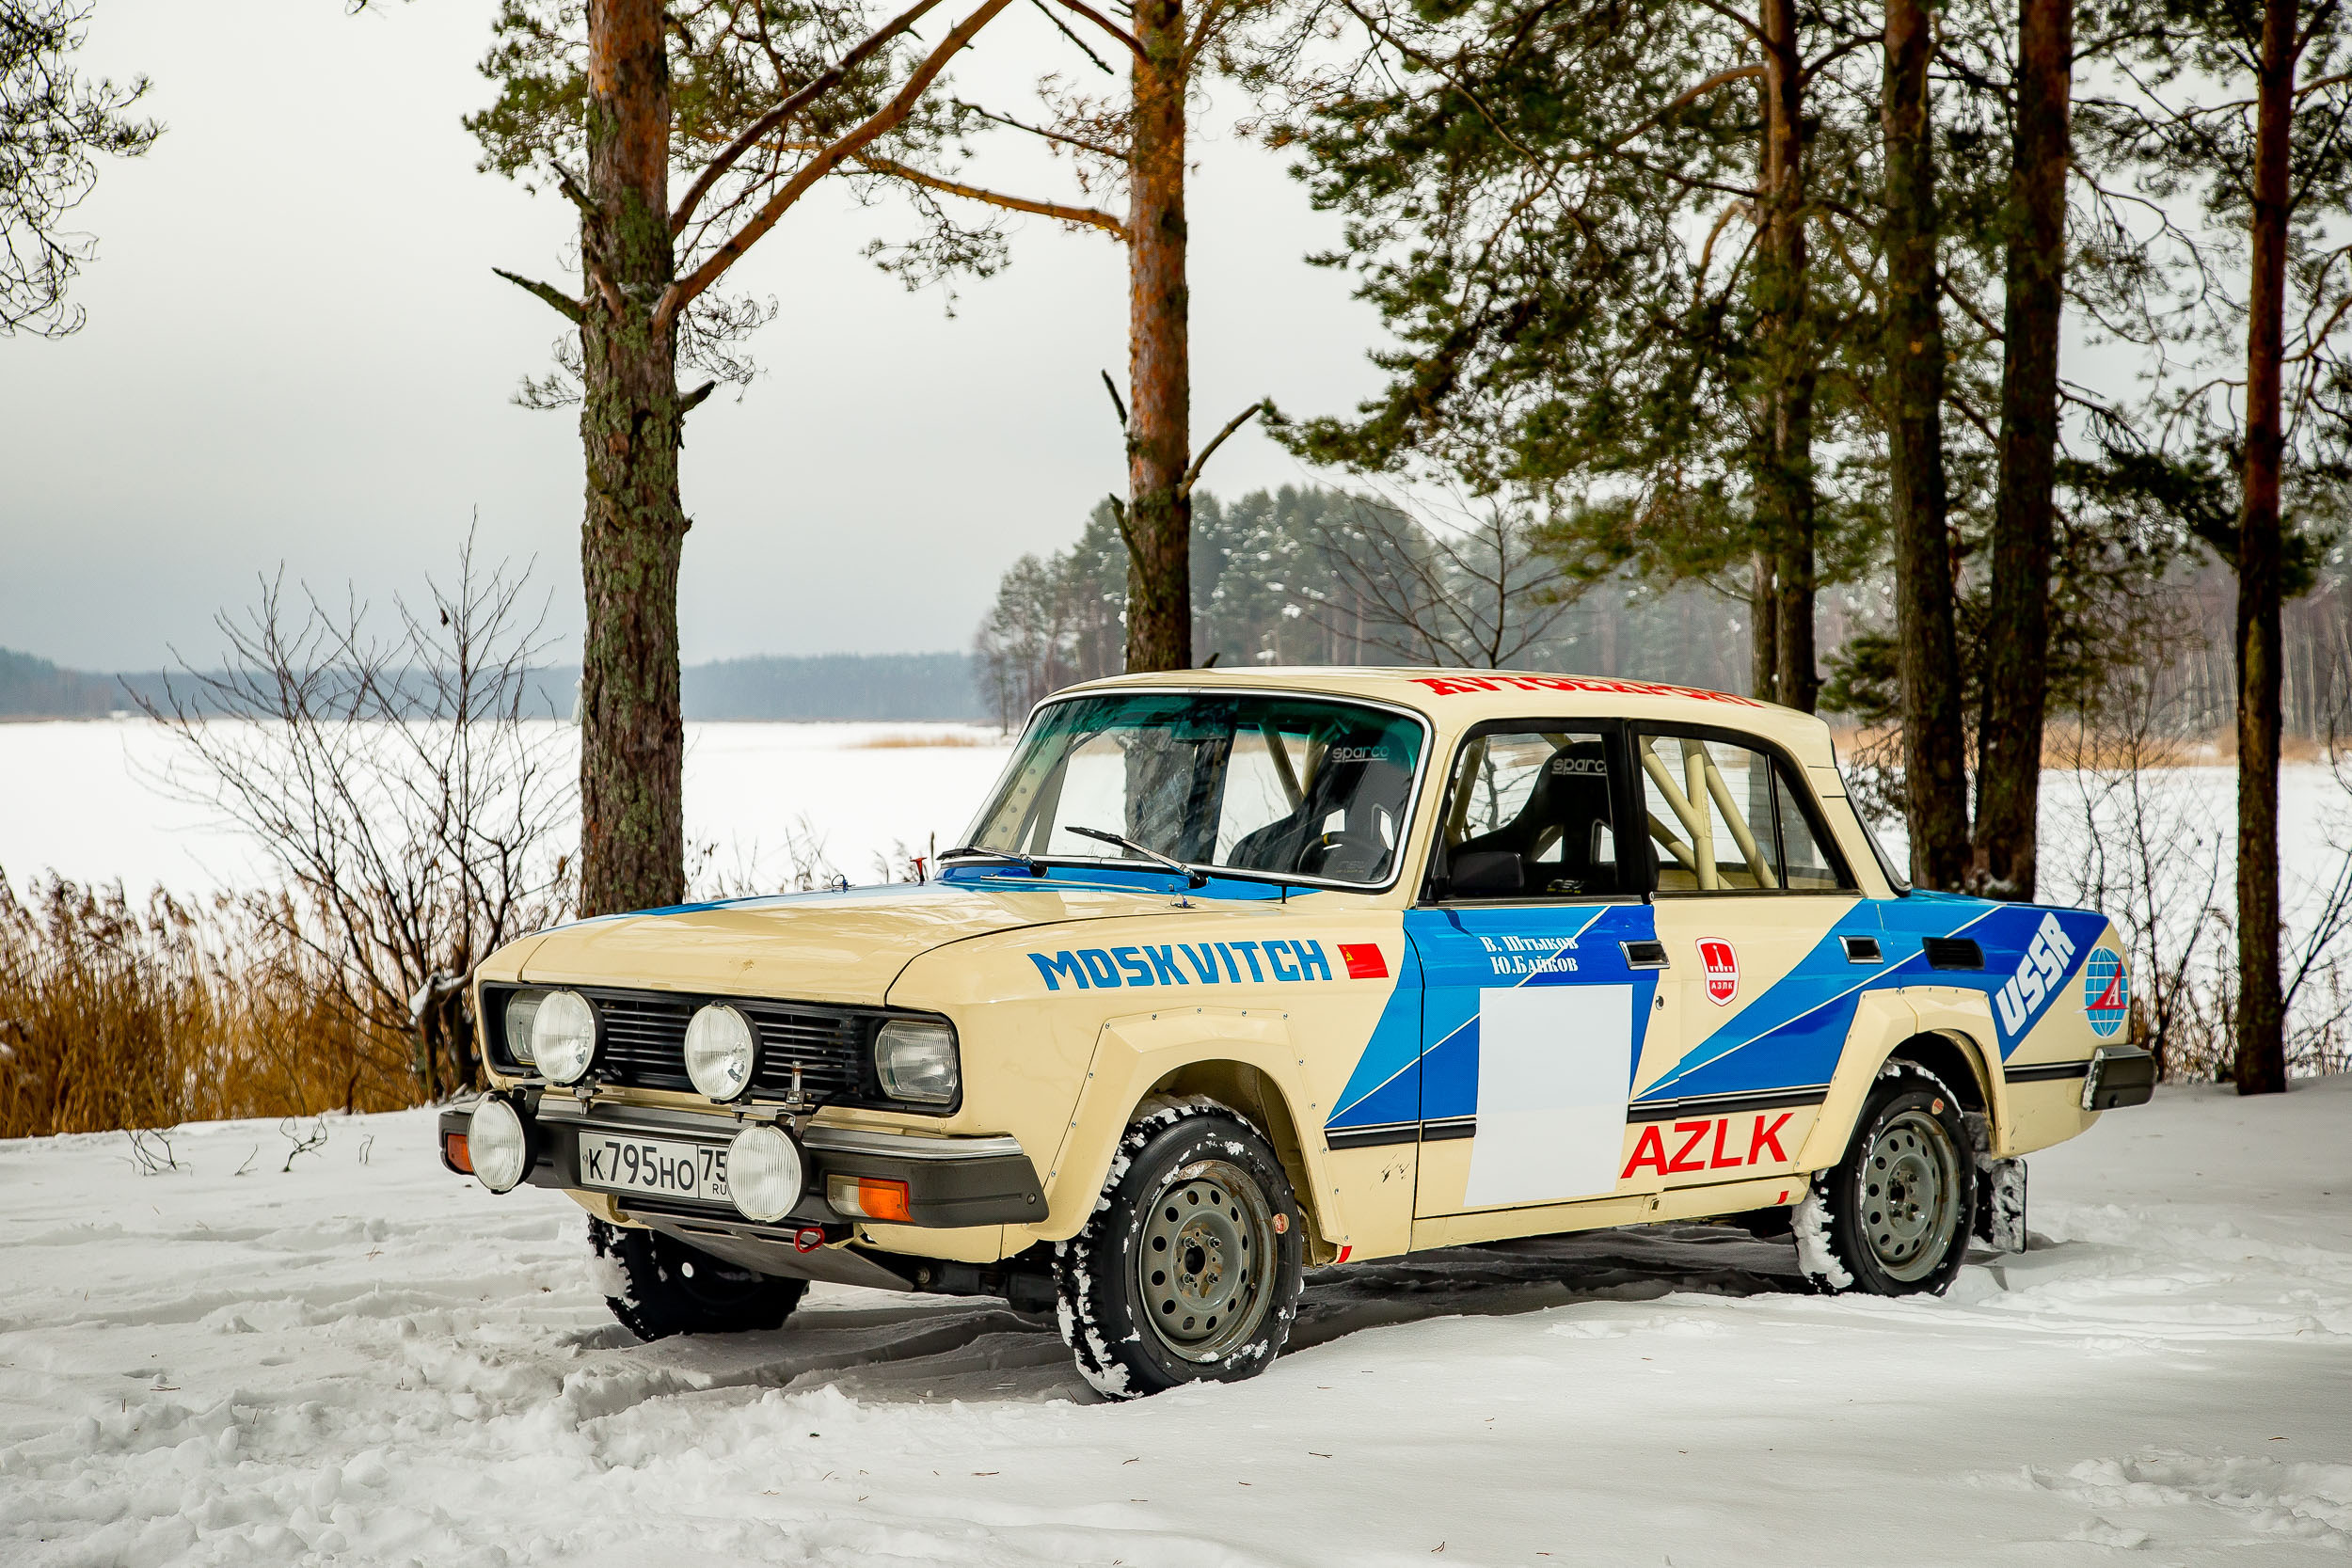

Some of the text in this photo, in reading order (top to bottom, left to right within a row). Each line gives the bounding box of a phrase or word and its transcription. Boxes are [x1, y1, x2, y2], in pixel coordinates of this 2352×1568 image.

[1332, 746, 1390, 763] sparco
[1552, 758, 1607, 775] sparc
[1026, 940, 1333, 990] MOSKVITCH
[1995, 911, 2076, 1037] USSR
[1711, 981, 1733, 990] АЗЛК
[1620, 1112, 1795, 1179] AZLK
[712, 1183, 727, 1196] RU
